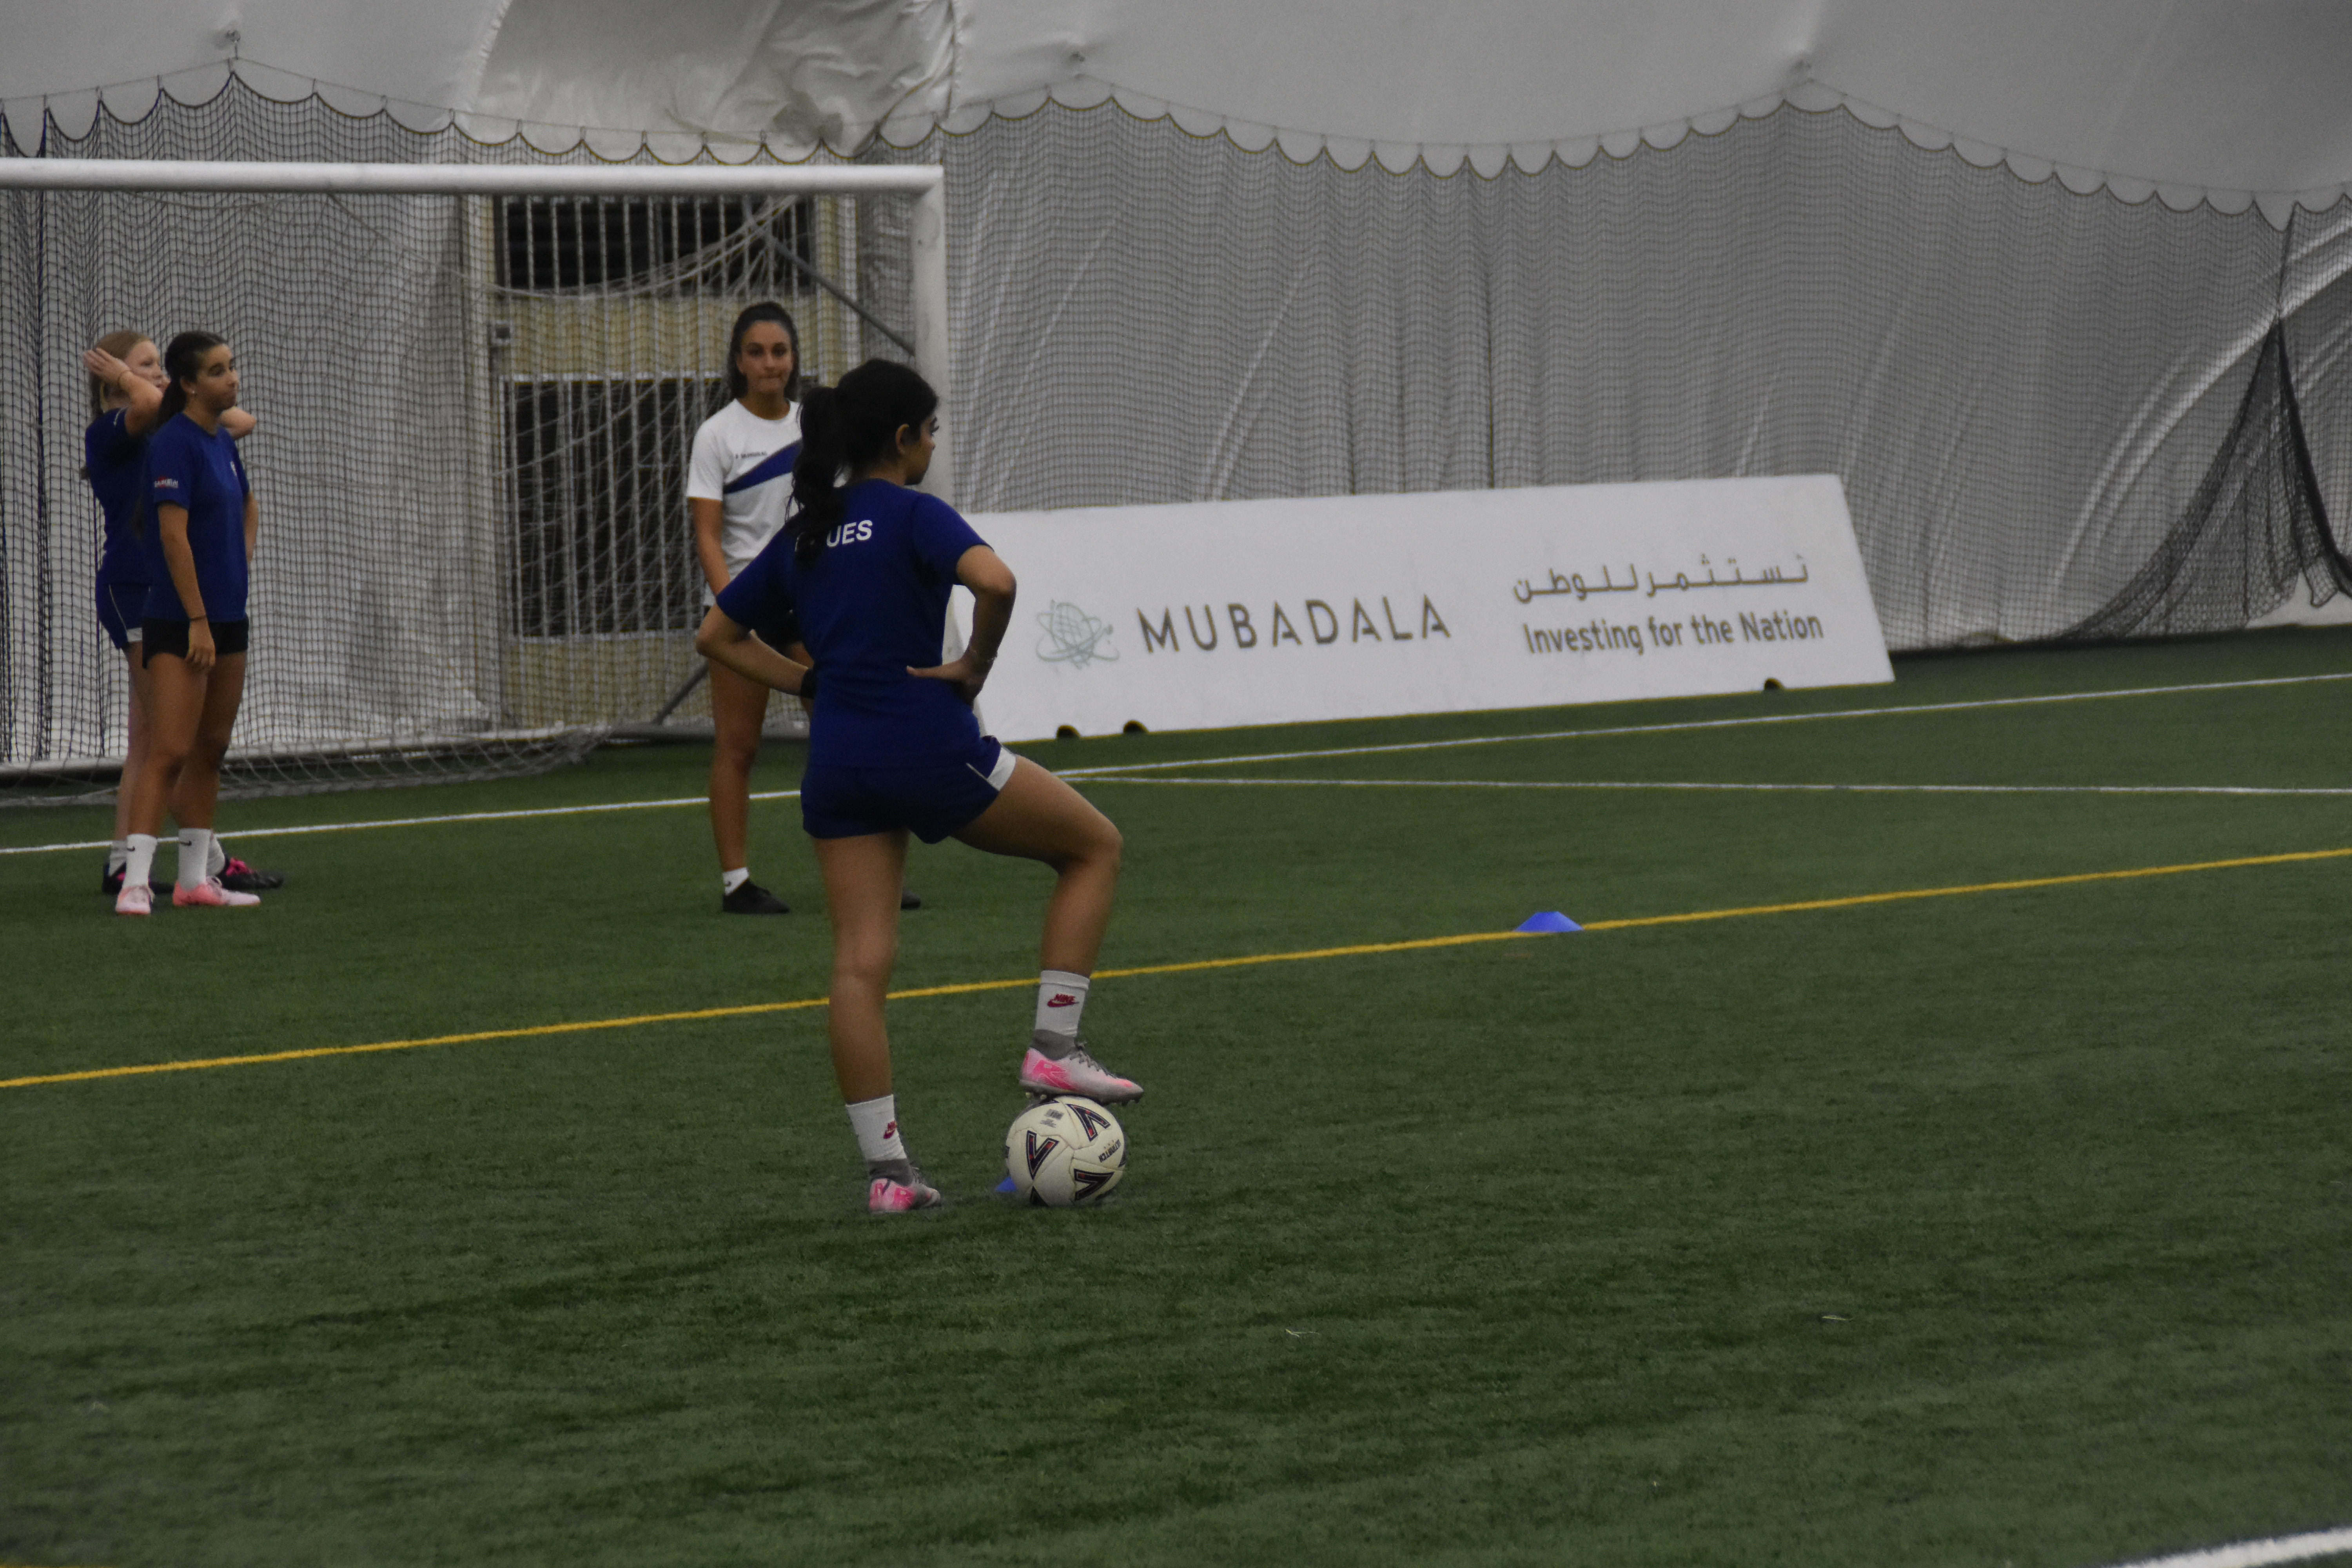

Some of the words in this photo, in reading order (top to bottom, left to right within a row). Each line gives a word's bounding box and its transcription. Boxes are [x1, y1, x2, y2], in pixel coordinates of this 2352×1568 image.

[1514, 564, 1639, 604] للوطن
[1646, 554, 1809, 599] نستثمر
[1136, 594, 1451, 654] MUBADALA
[1523, 619, 1644, 655] Investing
[1647, 615, 1683, 647] for
[1690, 614, 1735, 645] the
[1739, 610, 1824, 642] Nation
[1053, 993, 1075, 1003] NIKE
